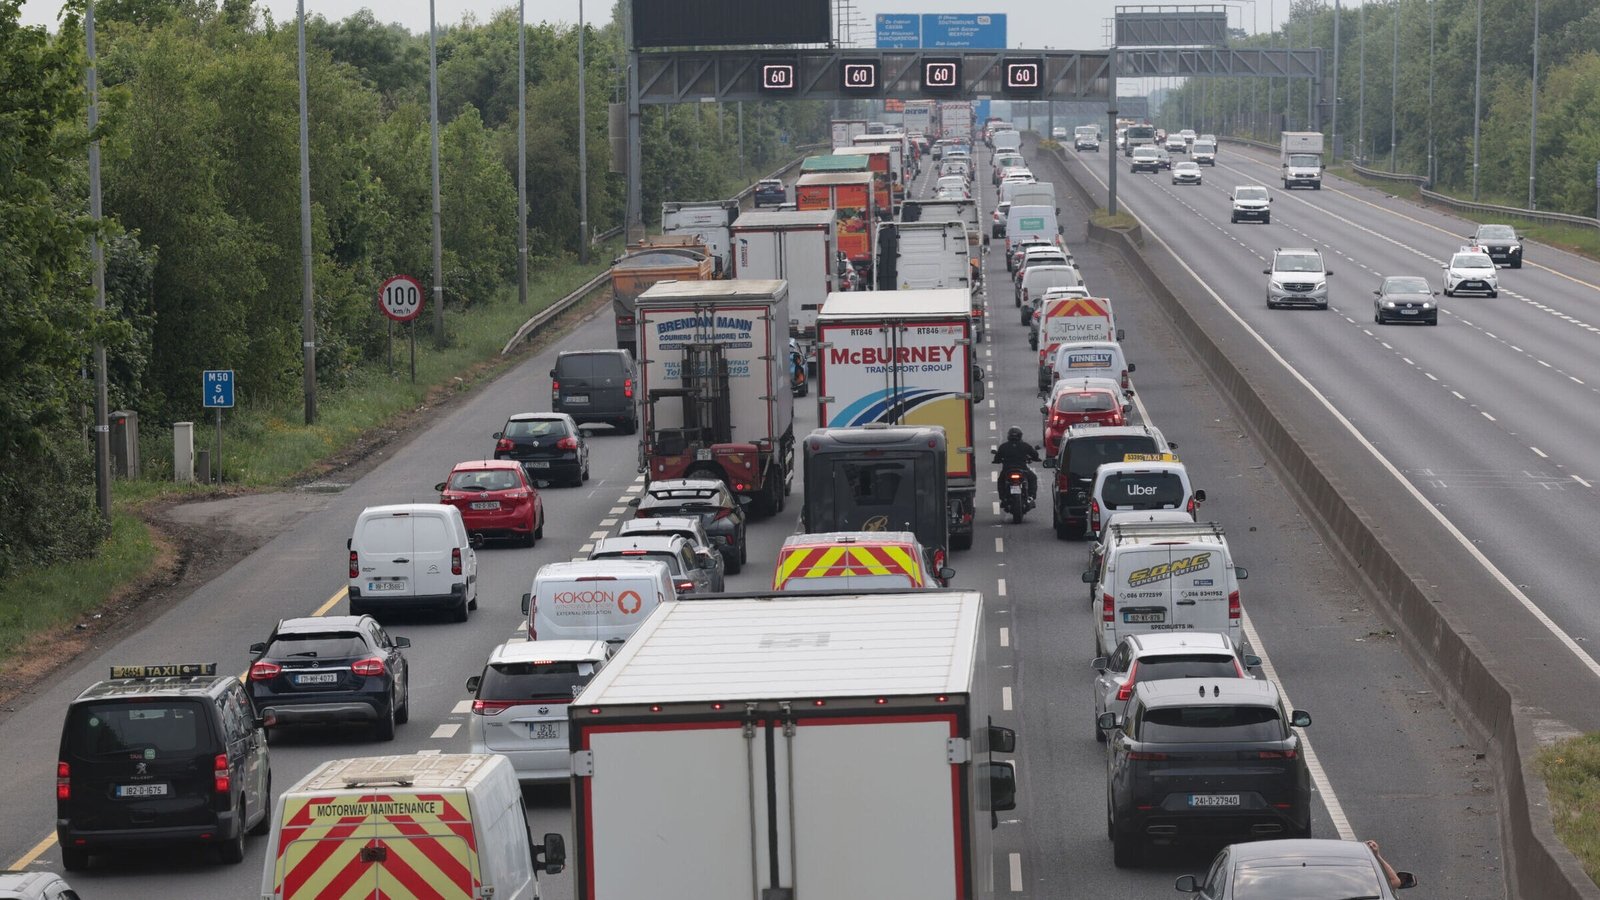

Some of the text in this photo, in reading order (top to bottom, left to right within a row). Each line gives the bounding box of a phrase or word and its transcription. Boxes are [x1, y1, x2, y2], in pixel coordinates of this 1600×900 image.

[771, 70, 786, 83] 60
[853, 70, 867, 82] 60
[934, 69, 948, 81] 60
[1016, 69, 1029, 82] 60
[386, 286, 416, 305] 100
[657, 316, 752, 334] BRENDAN MANN
[831, 346, 956, 365] McBURNEY
[865, 365, 919, 373] TRANSPORT
[215, 384, 222, 393] S
[212, 395, 224, 404] 14
[1127, 485, 1157, 495] Uber
[1174, 562, 1210, 576] CUTTING
[554, 591, 614, 604] KOKOON
[148, 666, 176, 676] TAXI
[126, 786, 162, 795] 182-D-1675
[1195, 796, 1237, 805] 241-D-27940
[317, 802, 435, 816] MOTORWAY MAINTENANCE
